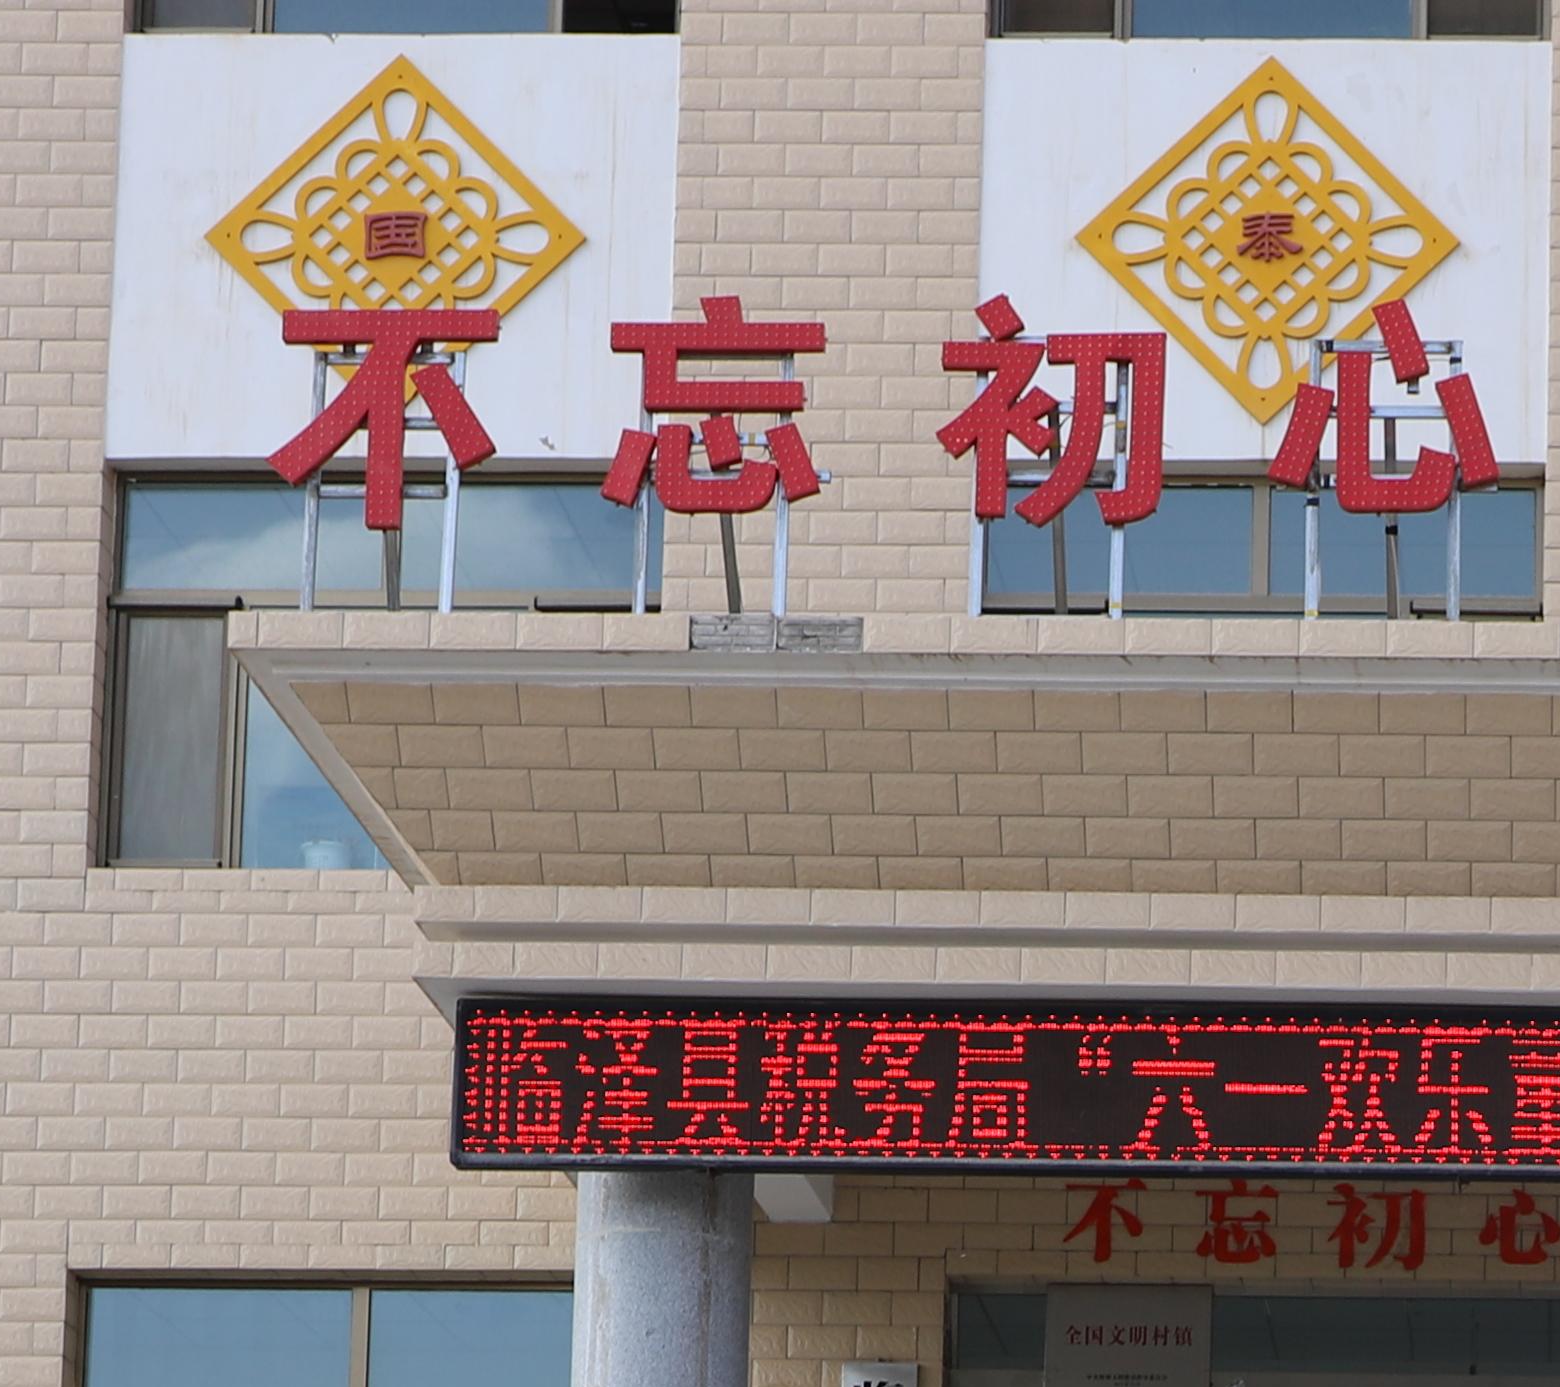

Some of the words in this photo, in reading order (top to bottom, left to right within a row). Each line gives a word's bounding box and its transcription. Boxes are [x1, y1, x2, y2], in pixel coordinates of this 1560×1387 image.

[364, 211, 428, 261] 国
[1239, 210, 1304, 263] 泰
[266, 295, 1500, 531] 不忘初心
[1066, 1325, 1193, 1346] 全国文明村镇
